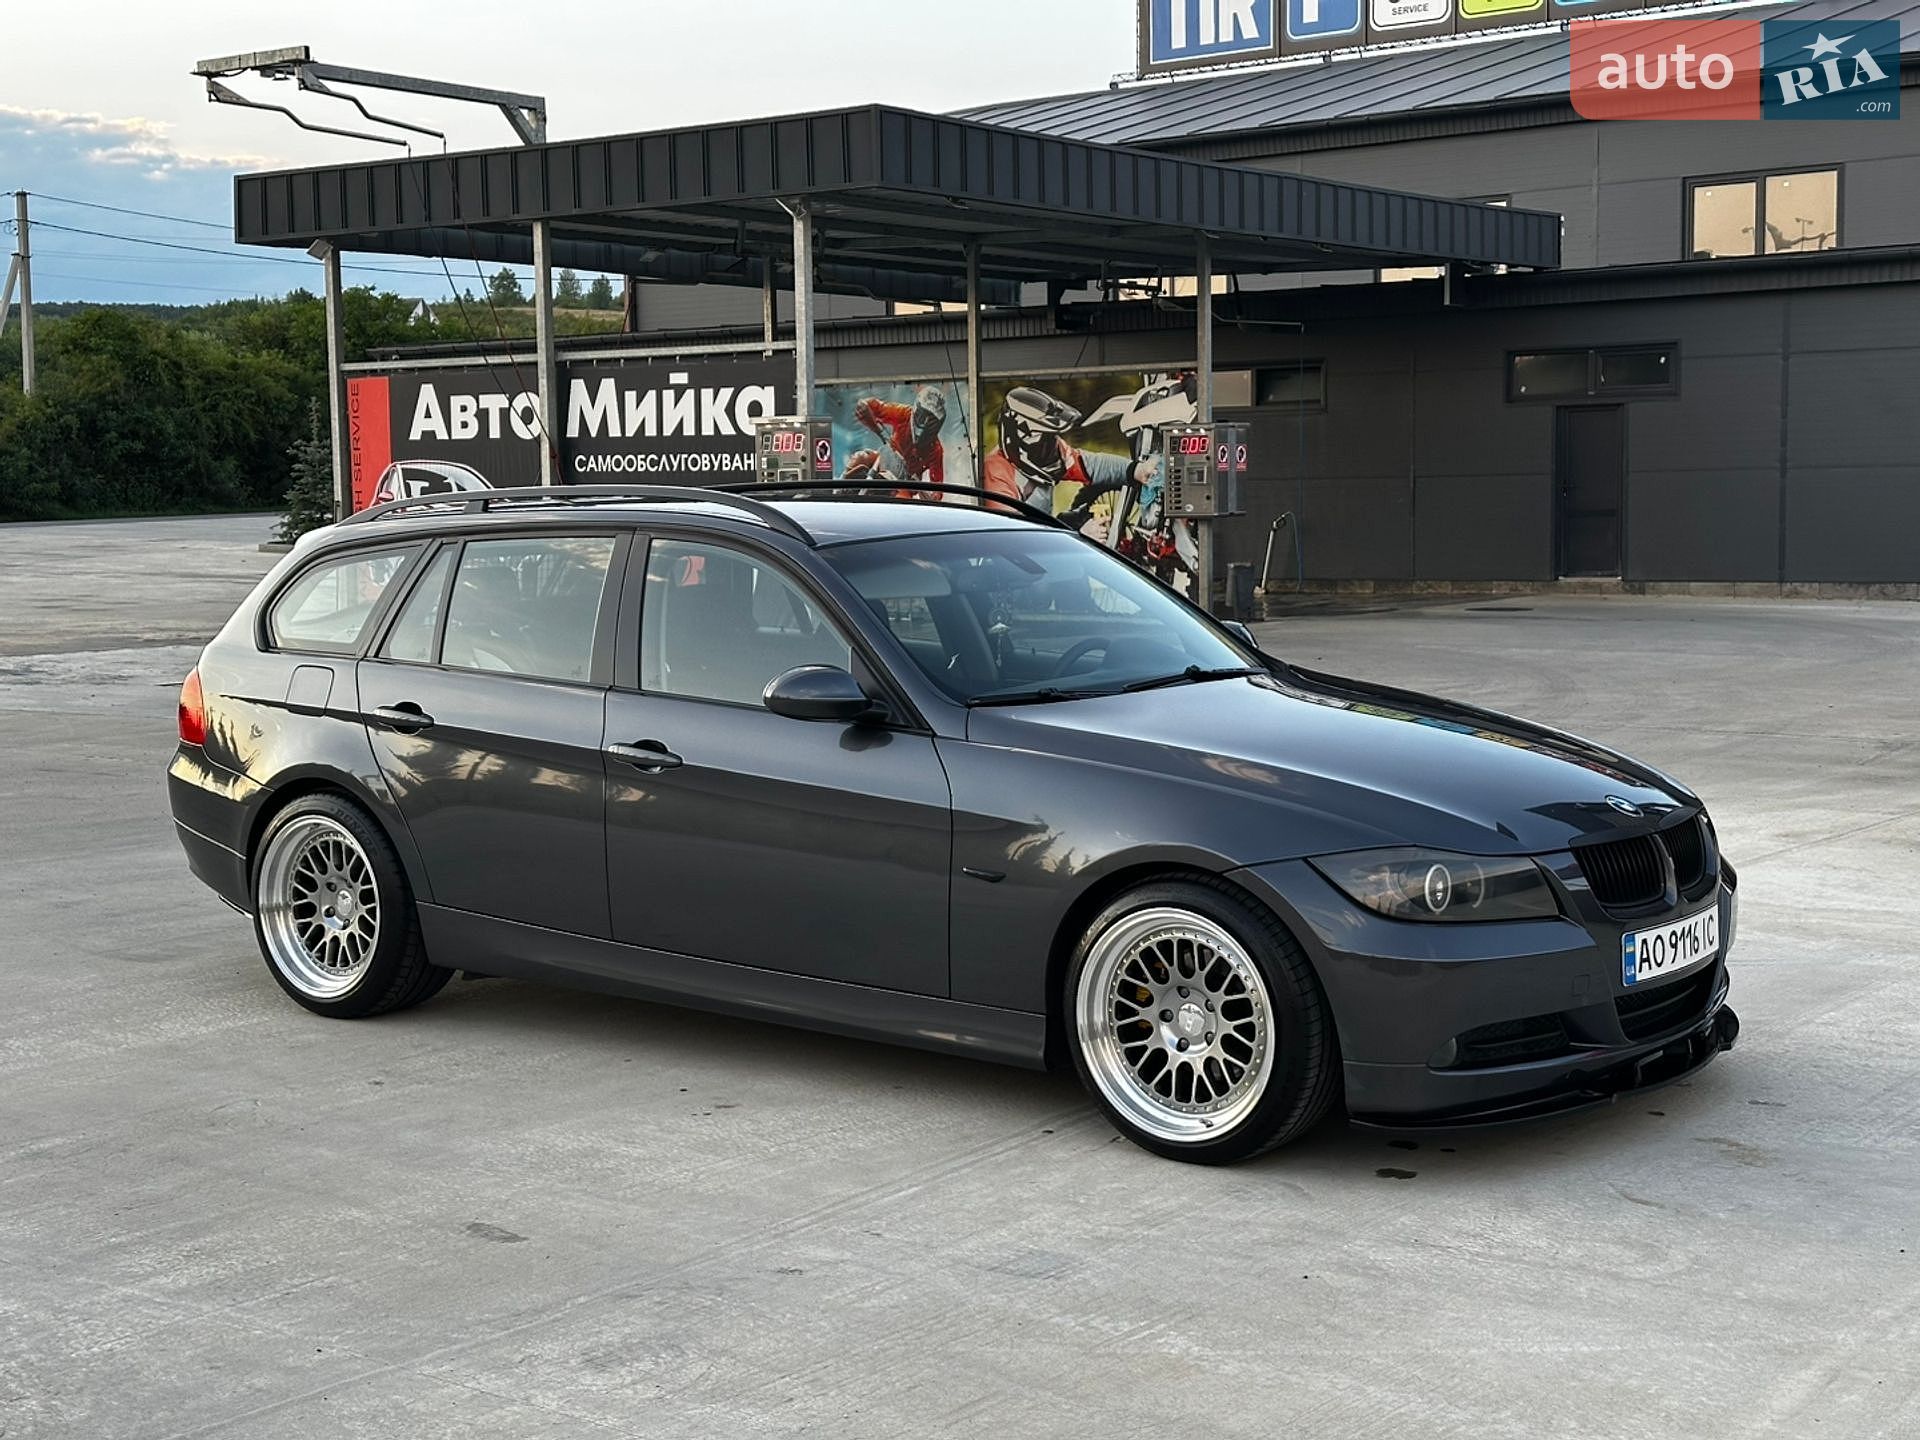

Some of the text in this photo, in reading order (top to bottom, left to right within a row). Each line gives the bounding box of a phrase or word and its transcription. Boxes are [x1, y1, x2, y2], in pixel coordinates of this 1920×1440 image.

[1391, 4, 1430, 17] SERVICE
[350, 383, 363, 482] SERVICE
[566, 372, 775, 438] Мийка
[574, 453, 758, 473] САМООБСЛУГОВУВАН
[1638, 914, 1715, 973] AO 9116 IC
